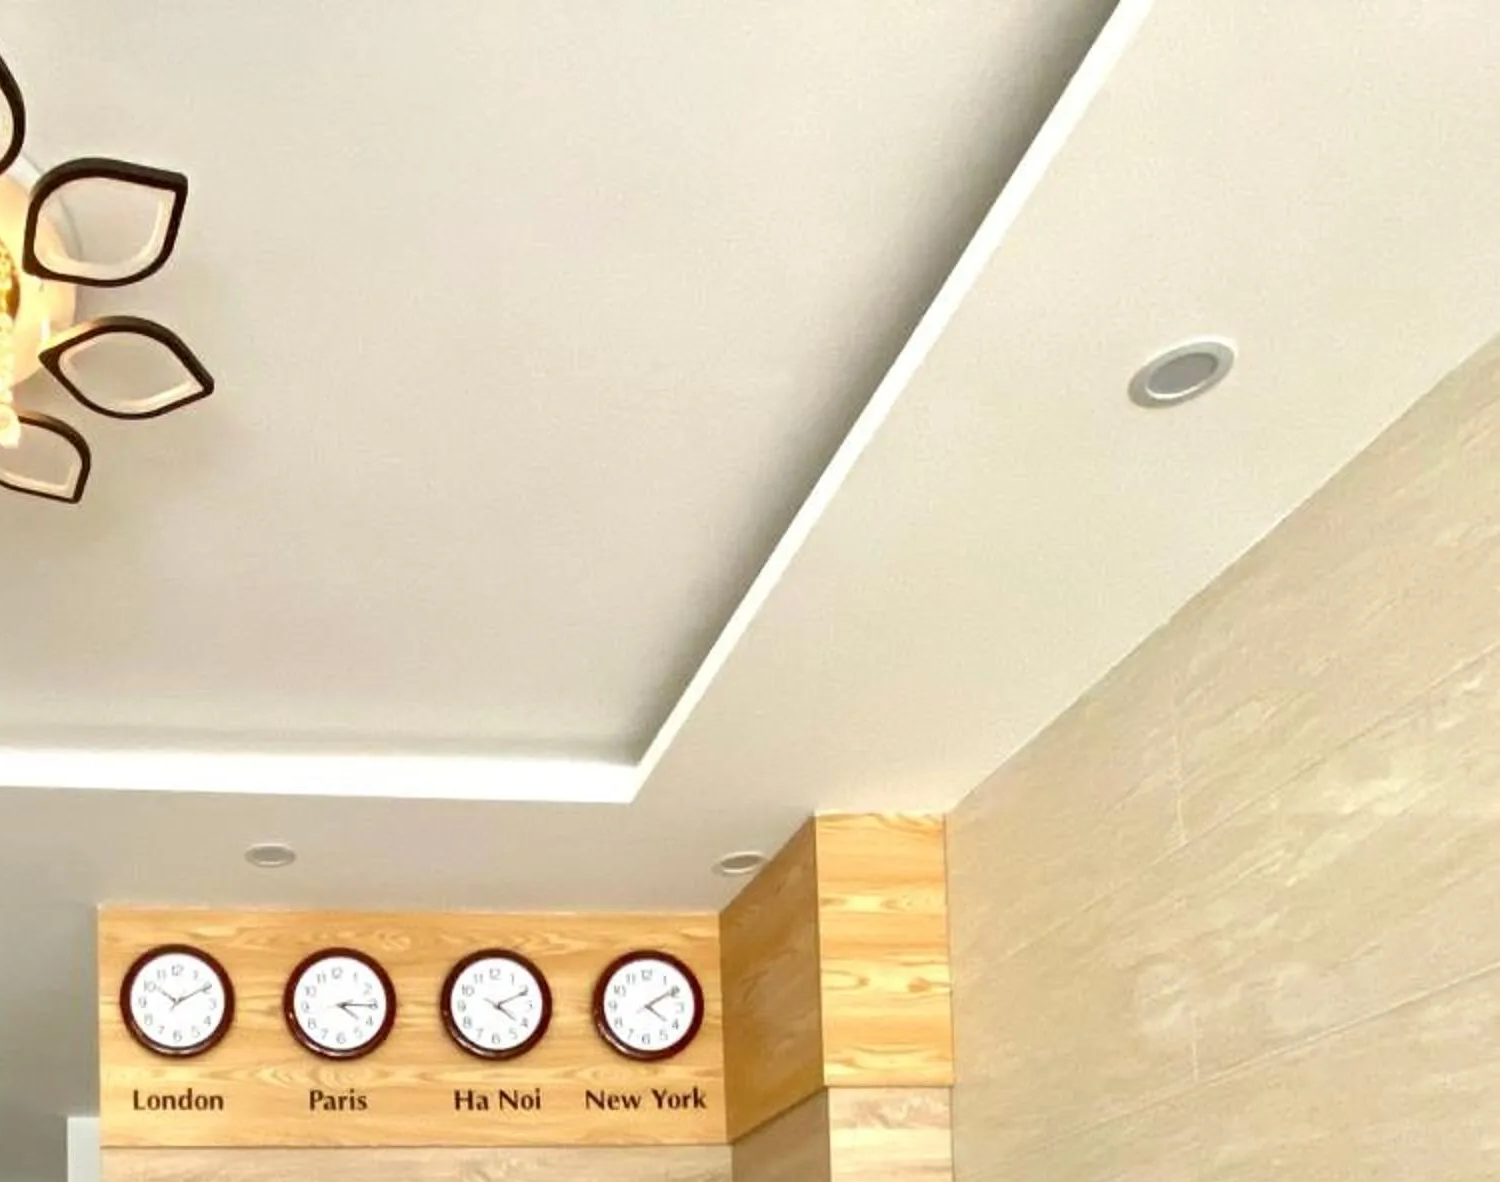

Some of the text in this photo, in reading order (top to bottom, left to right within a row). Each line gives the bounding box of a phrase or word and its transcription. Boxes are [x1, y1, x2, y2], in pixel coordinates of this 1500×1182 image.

[132, 1088, 224, 1111] London
[308, 1088, 368, 1111] Paris
[453, 1088, 541, 1111] Ha Noi
[584, 1086, 707, 1111] New York
